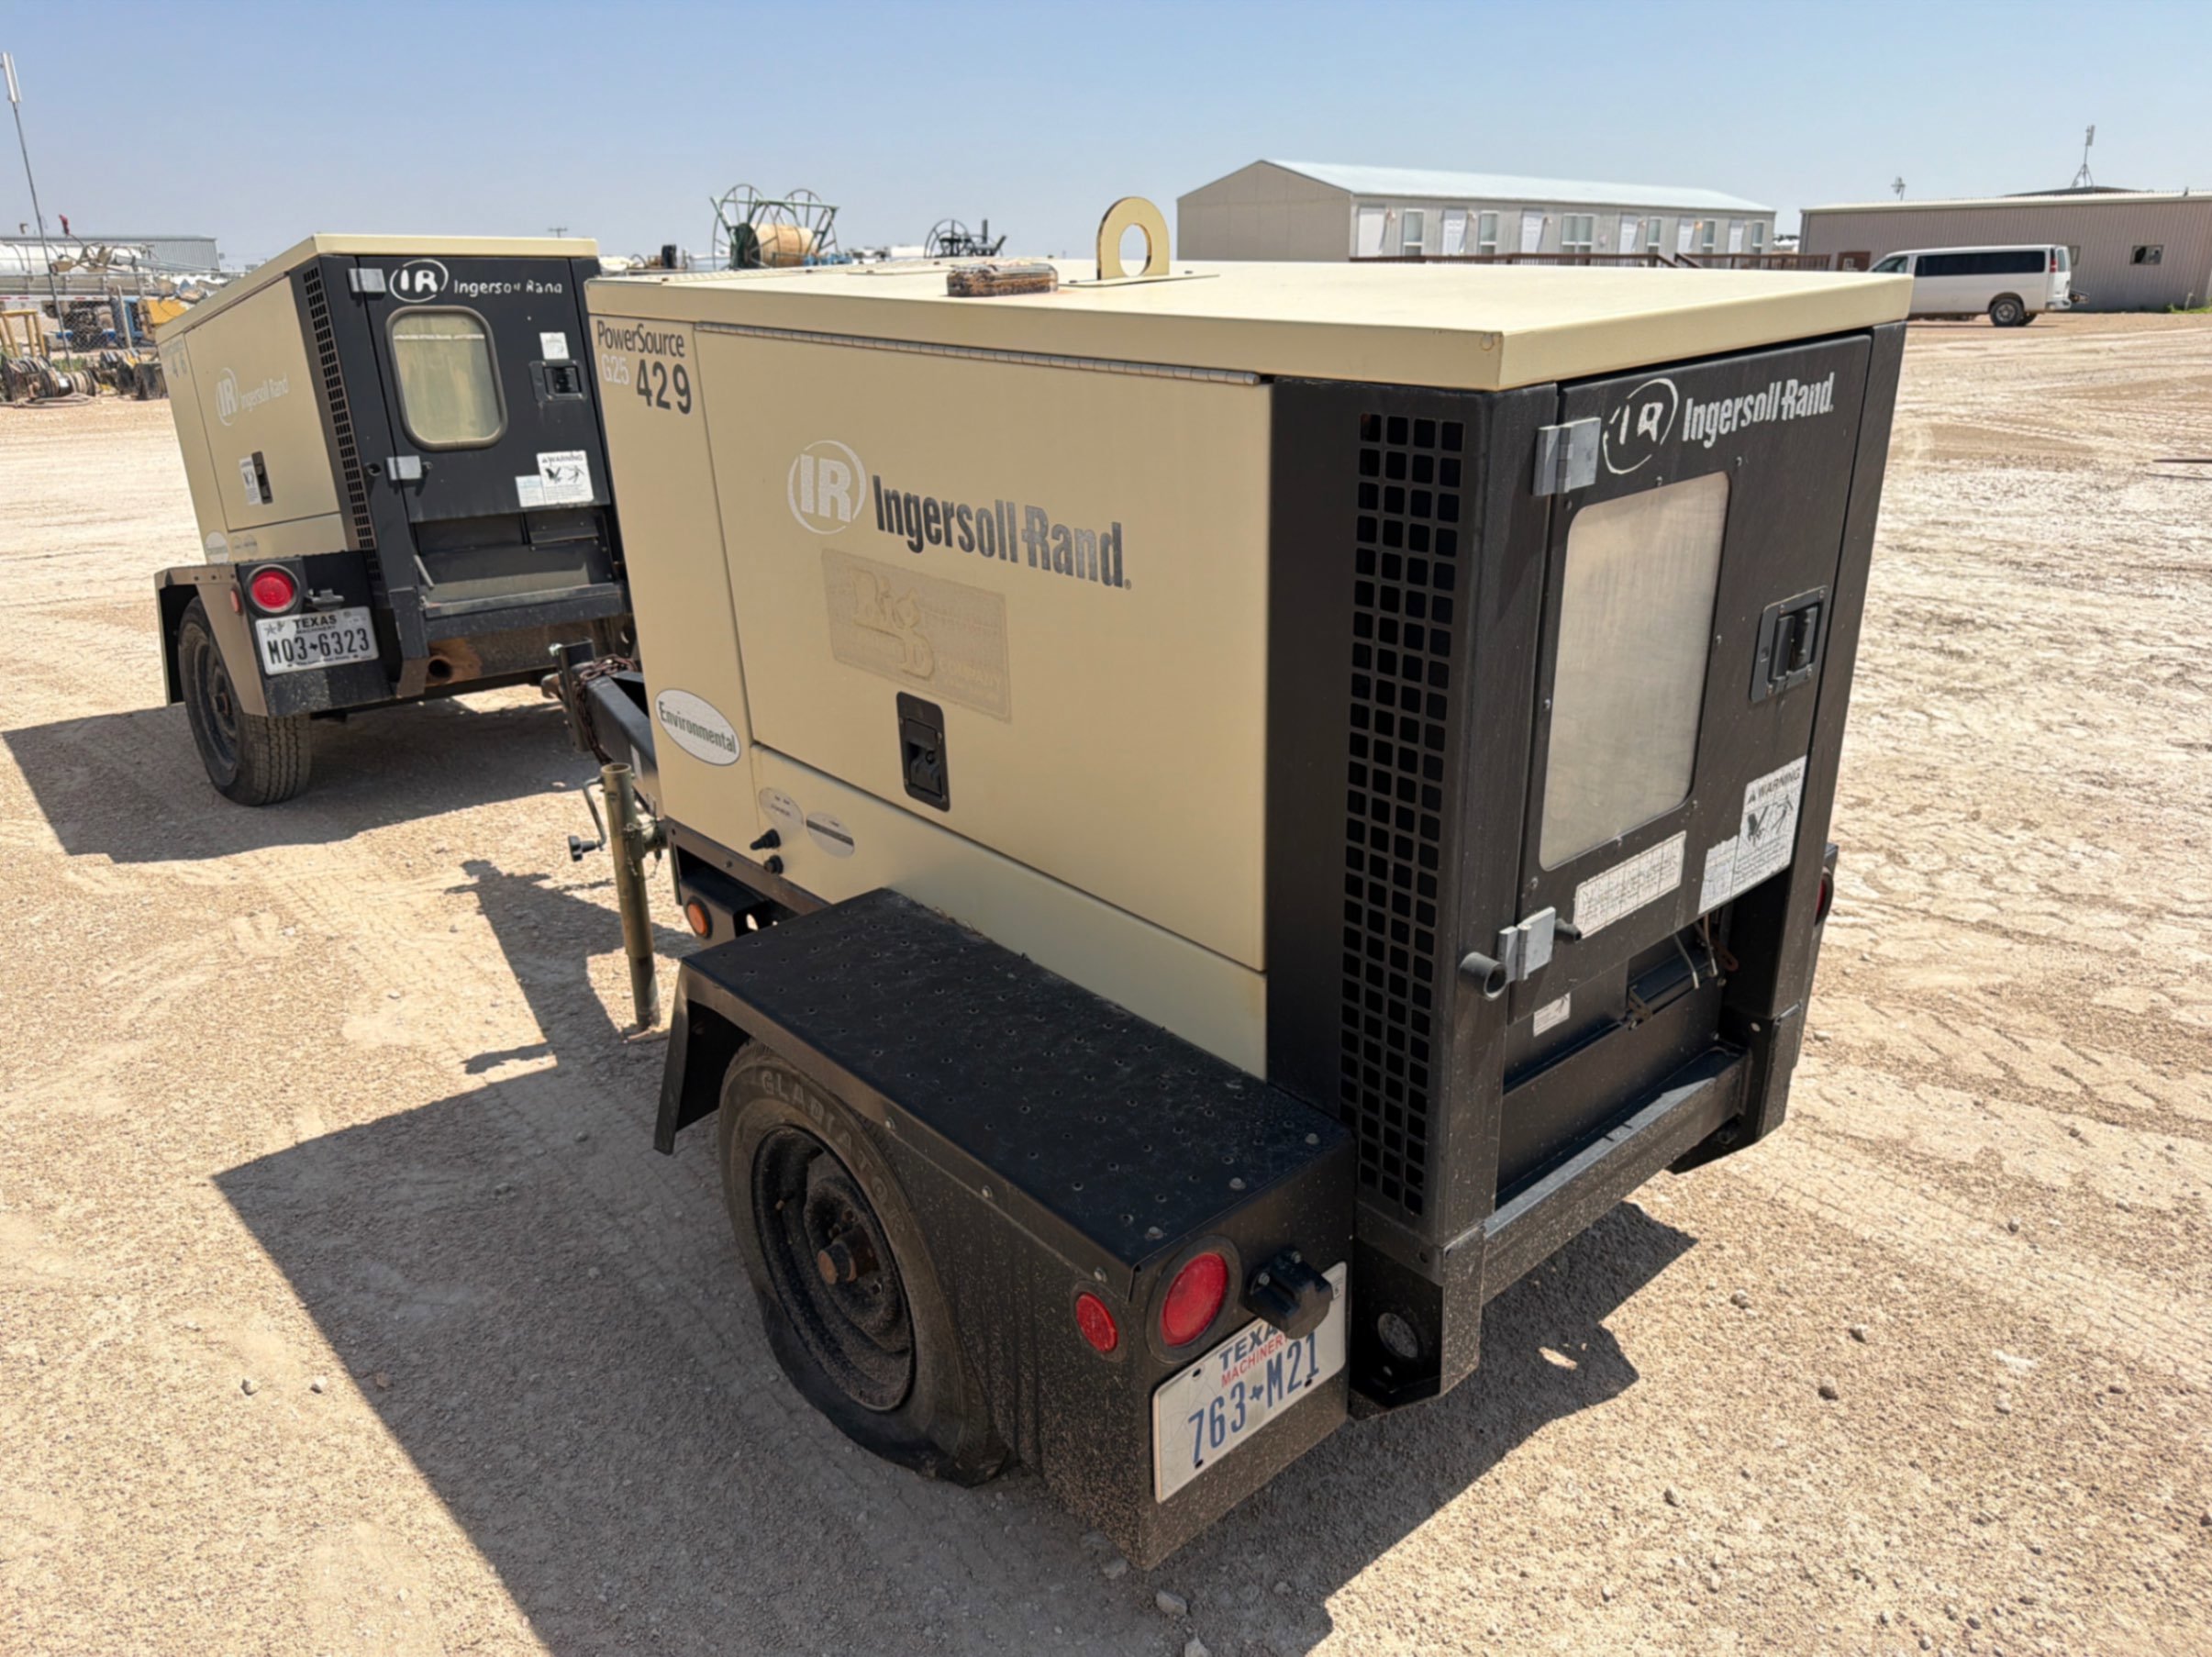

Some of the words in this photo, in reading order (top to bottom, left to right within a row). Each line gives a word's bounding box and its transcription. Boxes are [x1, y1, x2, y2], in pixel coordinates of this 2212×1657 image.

[597, 319, 685, 358] PowerSource
[601, 353, 630, 385] G25
[637, 359, 691, 415] 429
[293, 615, 337, 628] TEXAS
[659, 701, 737, 754] Environmental
[1758, 766, 1801, 799] WARNING
[1219, 1322, 1283, 1372] TEXA
[1221, 1333, 1288, 1388] MACHINER
